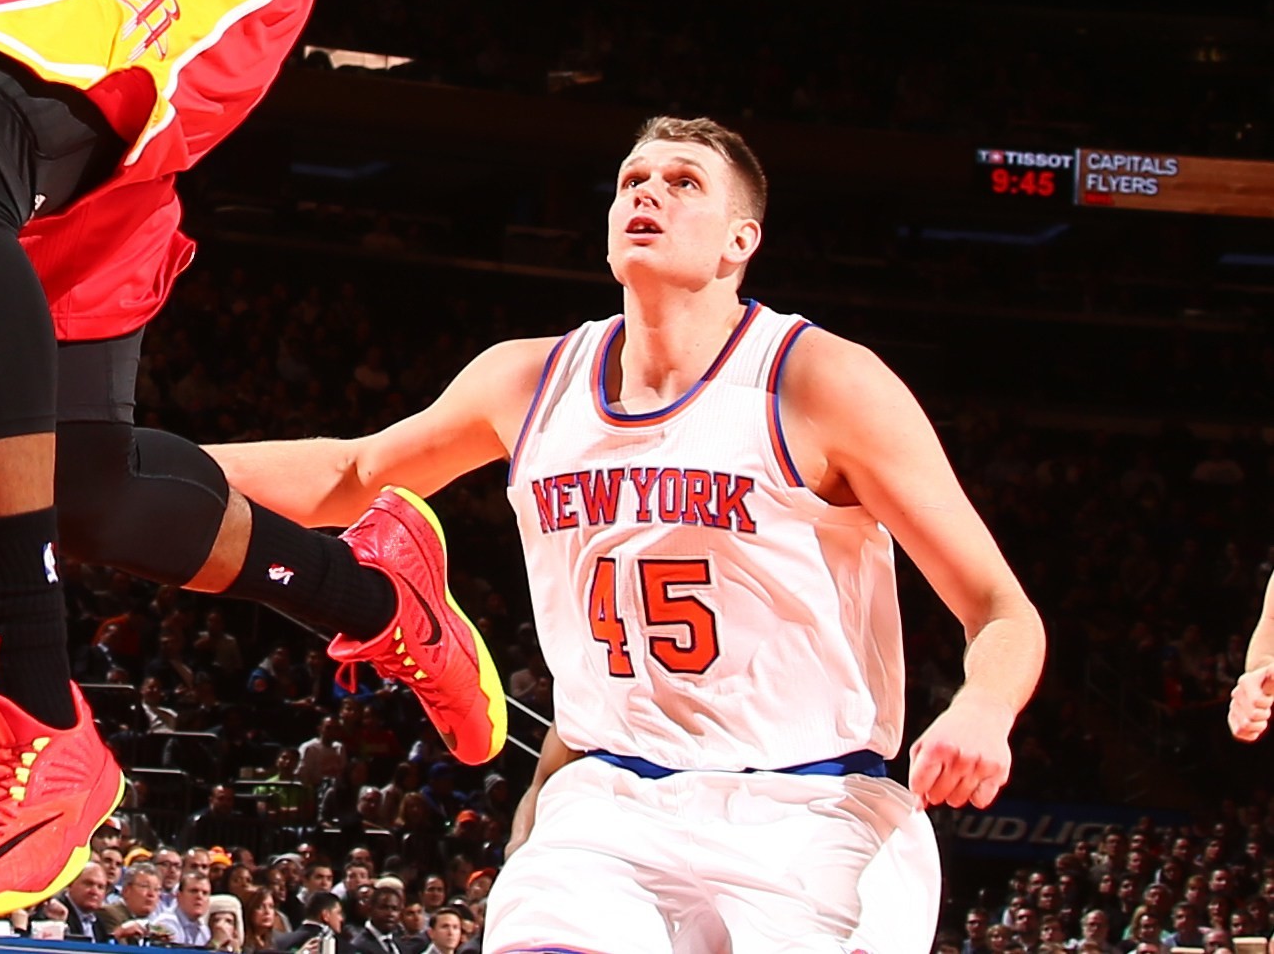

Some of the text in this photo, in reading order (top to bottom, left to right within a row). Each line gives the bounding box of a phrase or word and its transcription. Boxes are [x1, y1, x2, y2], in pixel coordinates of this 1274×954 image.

[1005, 151, 1075, 169] TISSOT
[1087, 152, 1179, 176] CAPITALS
[991, 168, 1056, 196] 9:45
[1086, 173, 1159, 195] FLYERS
[532, 467, 757, 534] NEW YORK
[588, 556, 721, 678] 45
